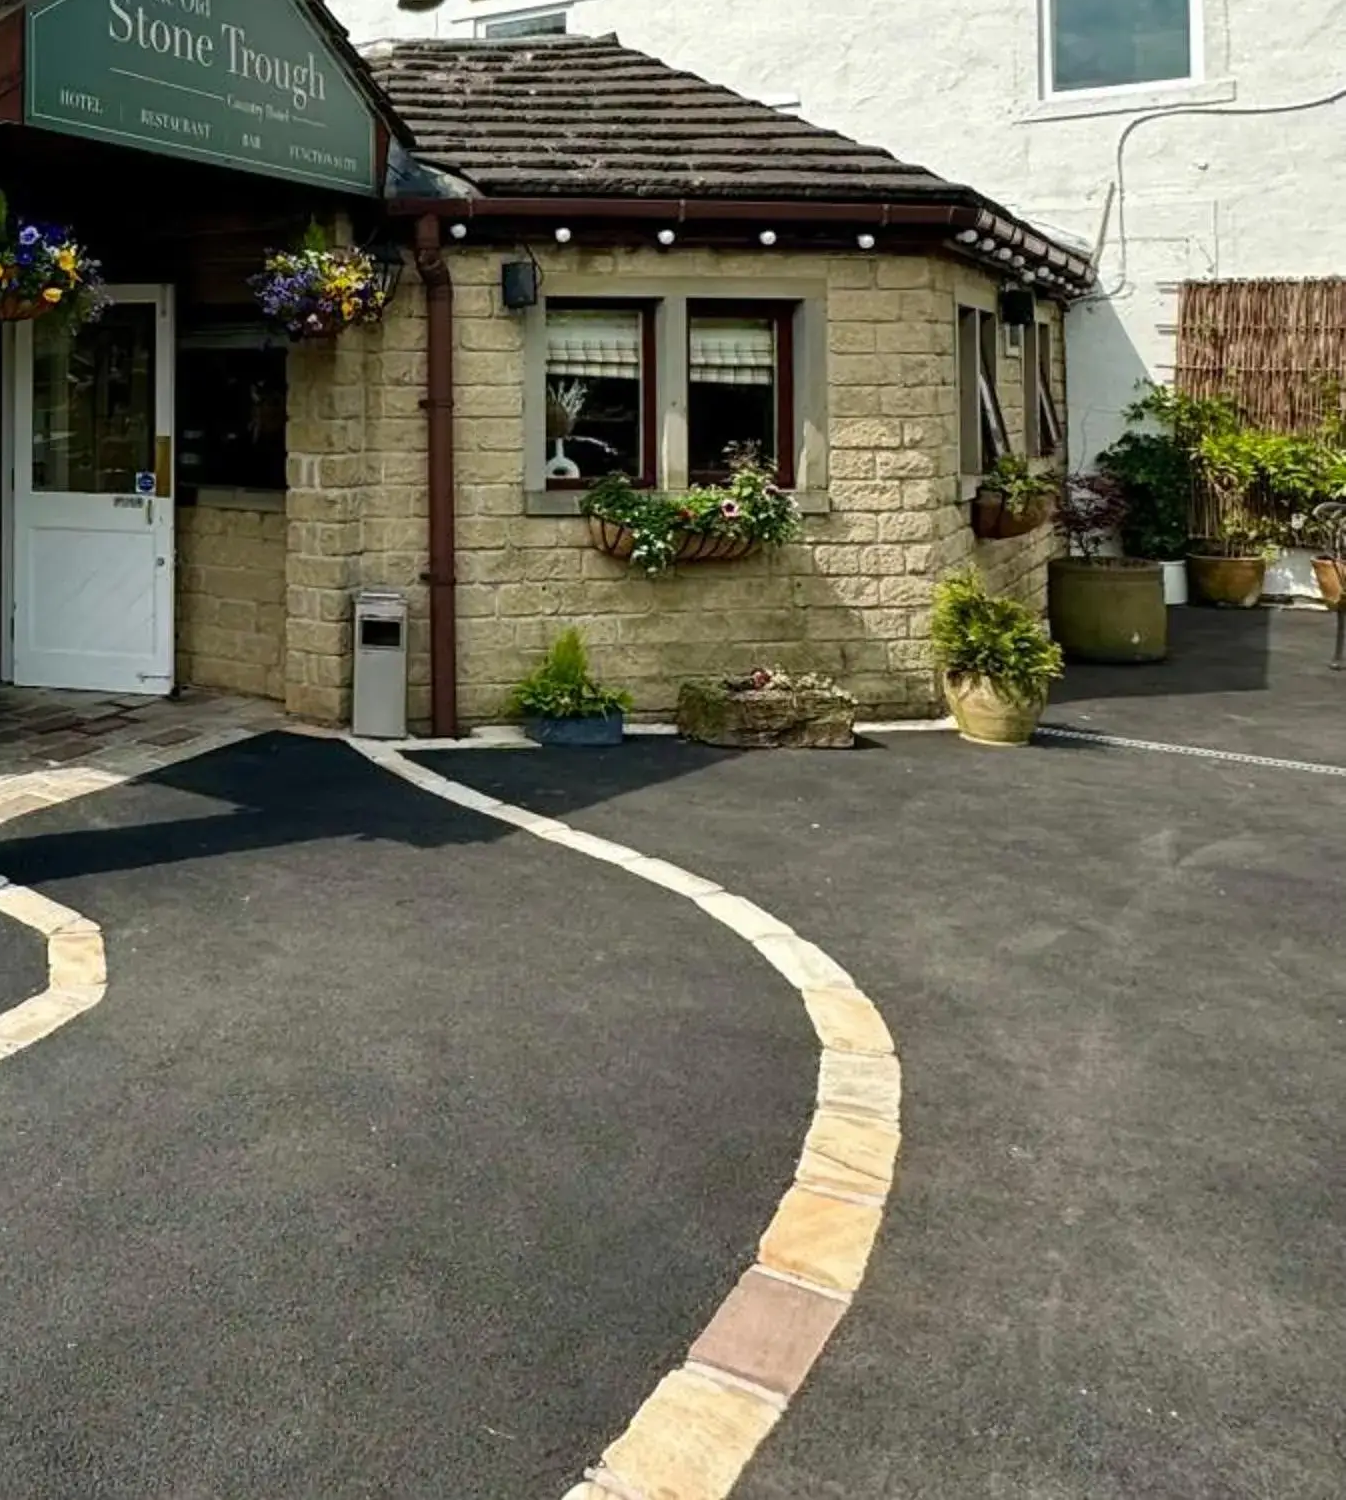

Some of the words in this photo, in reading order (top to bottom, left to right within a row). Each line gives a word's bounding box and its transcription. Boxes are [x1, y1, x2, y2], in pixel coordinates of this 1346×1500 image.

[220, 22, 326, 111] Trough
[59, 88, 103, 116] HOTEL
[141, 107, 212, 139] RESTAURANT
